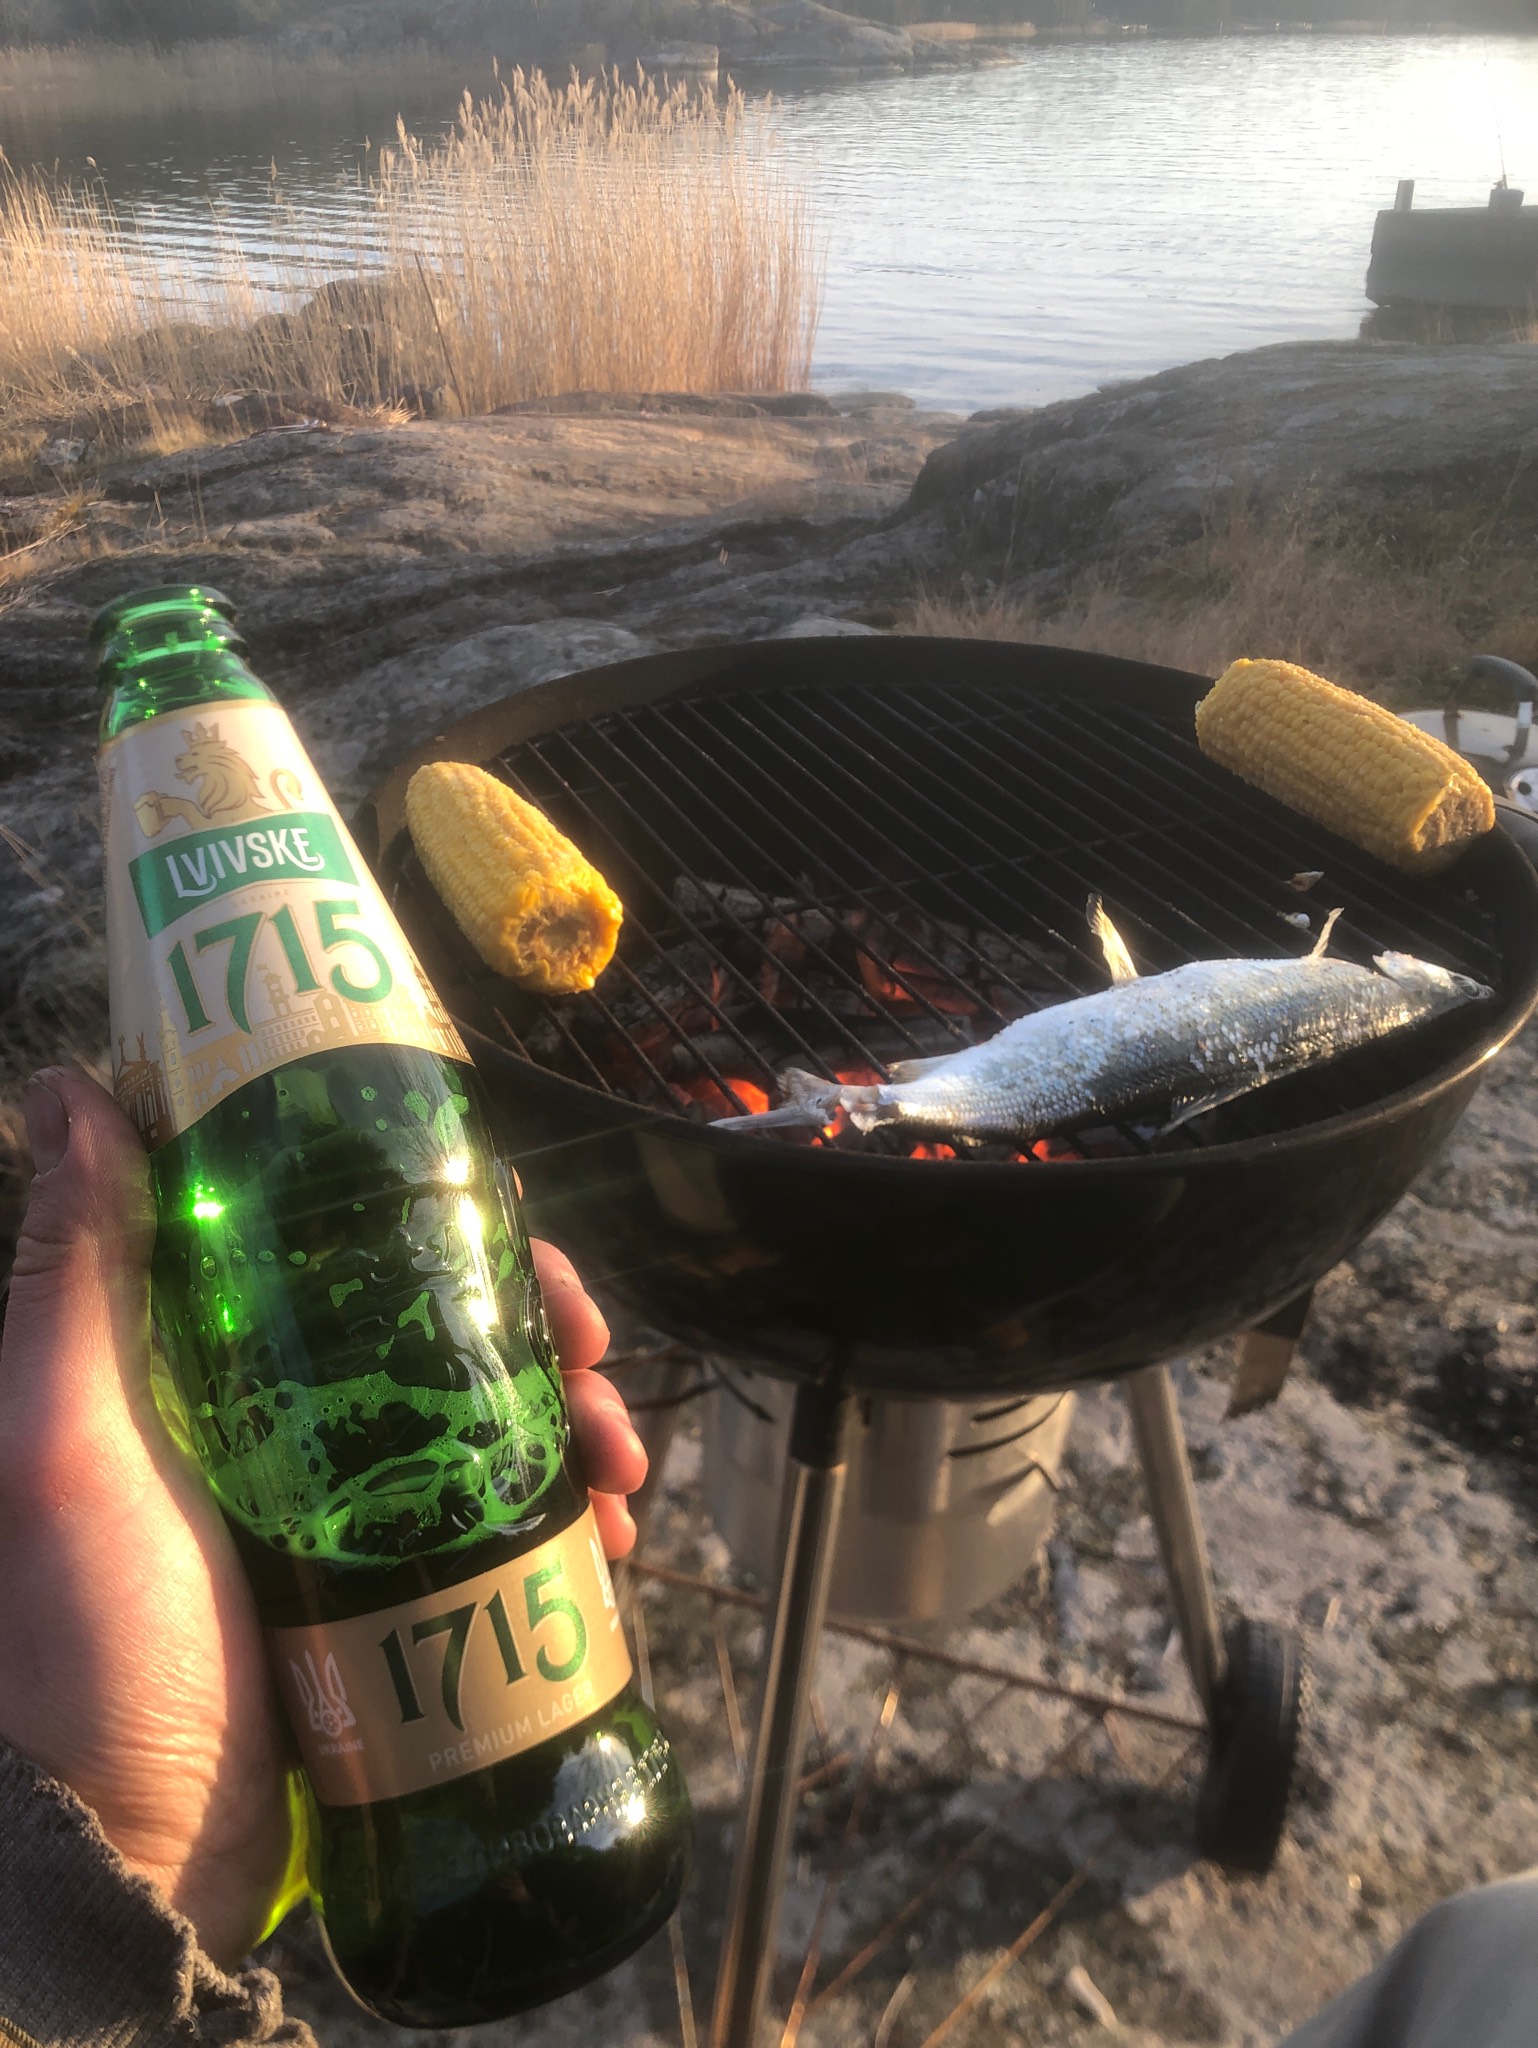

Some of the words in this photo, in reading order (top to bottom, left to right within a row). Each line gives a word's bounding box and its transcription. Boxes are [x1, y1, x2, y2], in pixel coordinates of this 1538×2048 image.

[165, 827, 326, 898] LVIVSKE
[166, 899, 393, 1036] 1715
[379, 1557, 588, 1732] 1715
[428, 1713, 533, 1773] PREMIUM
[537, 1679, 596, 1729] LAGER
